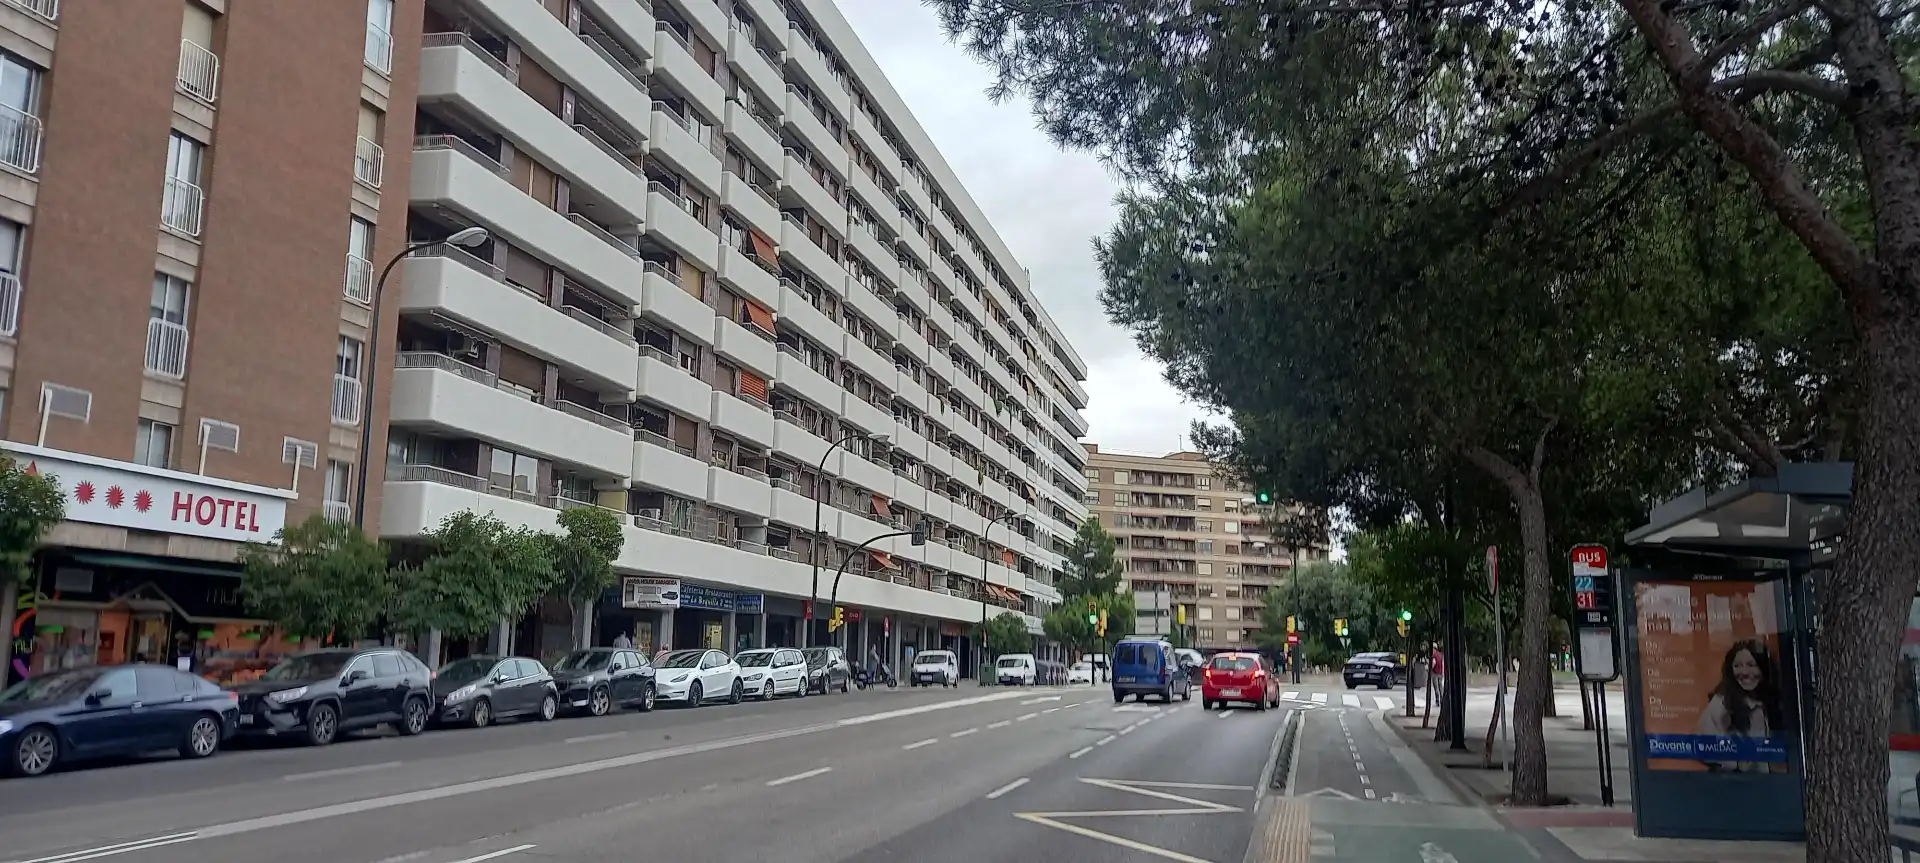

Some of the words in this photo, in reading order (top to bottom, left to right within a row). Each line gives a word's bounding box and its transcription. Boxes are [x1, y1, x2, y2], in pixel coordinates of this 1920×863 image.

[171, 491, 260, 533] HOTEL
[1578, 551, 1601, 562] BUS
[1575, 576, 1592, 590] 22
[1577, 592, 1593, 608] 31
[1649, 739, 1692, 752] Davante
